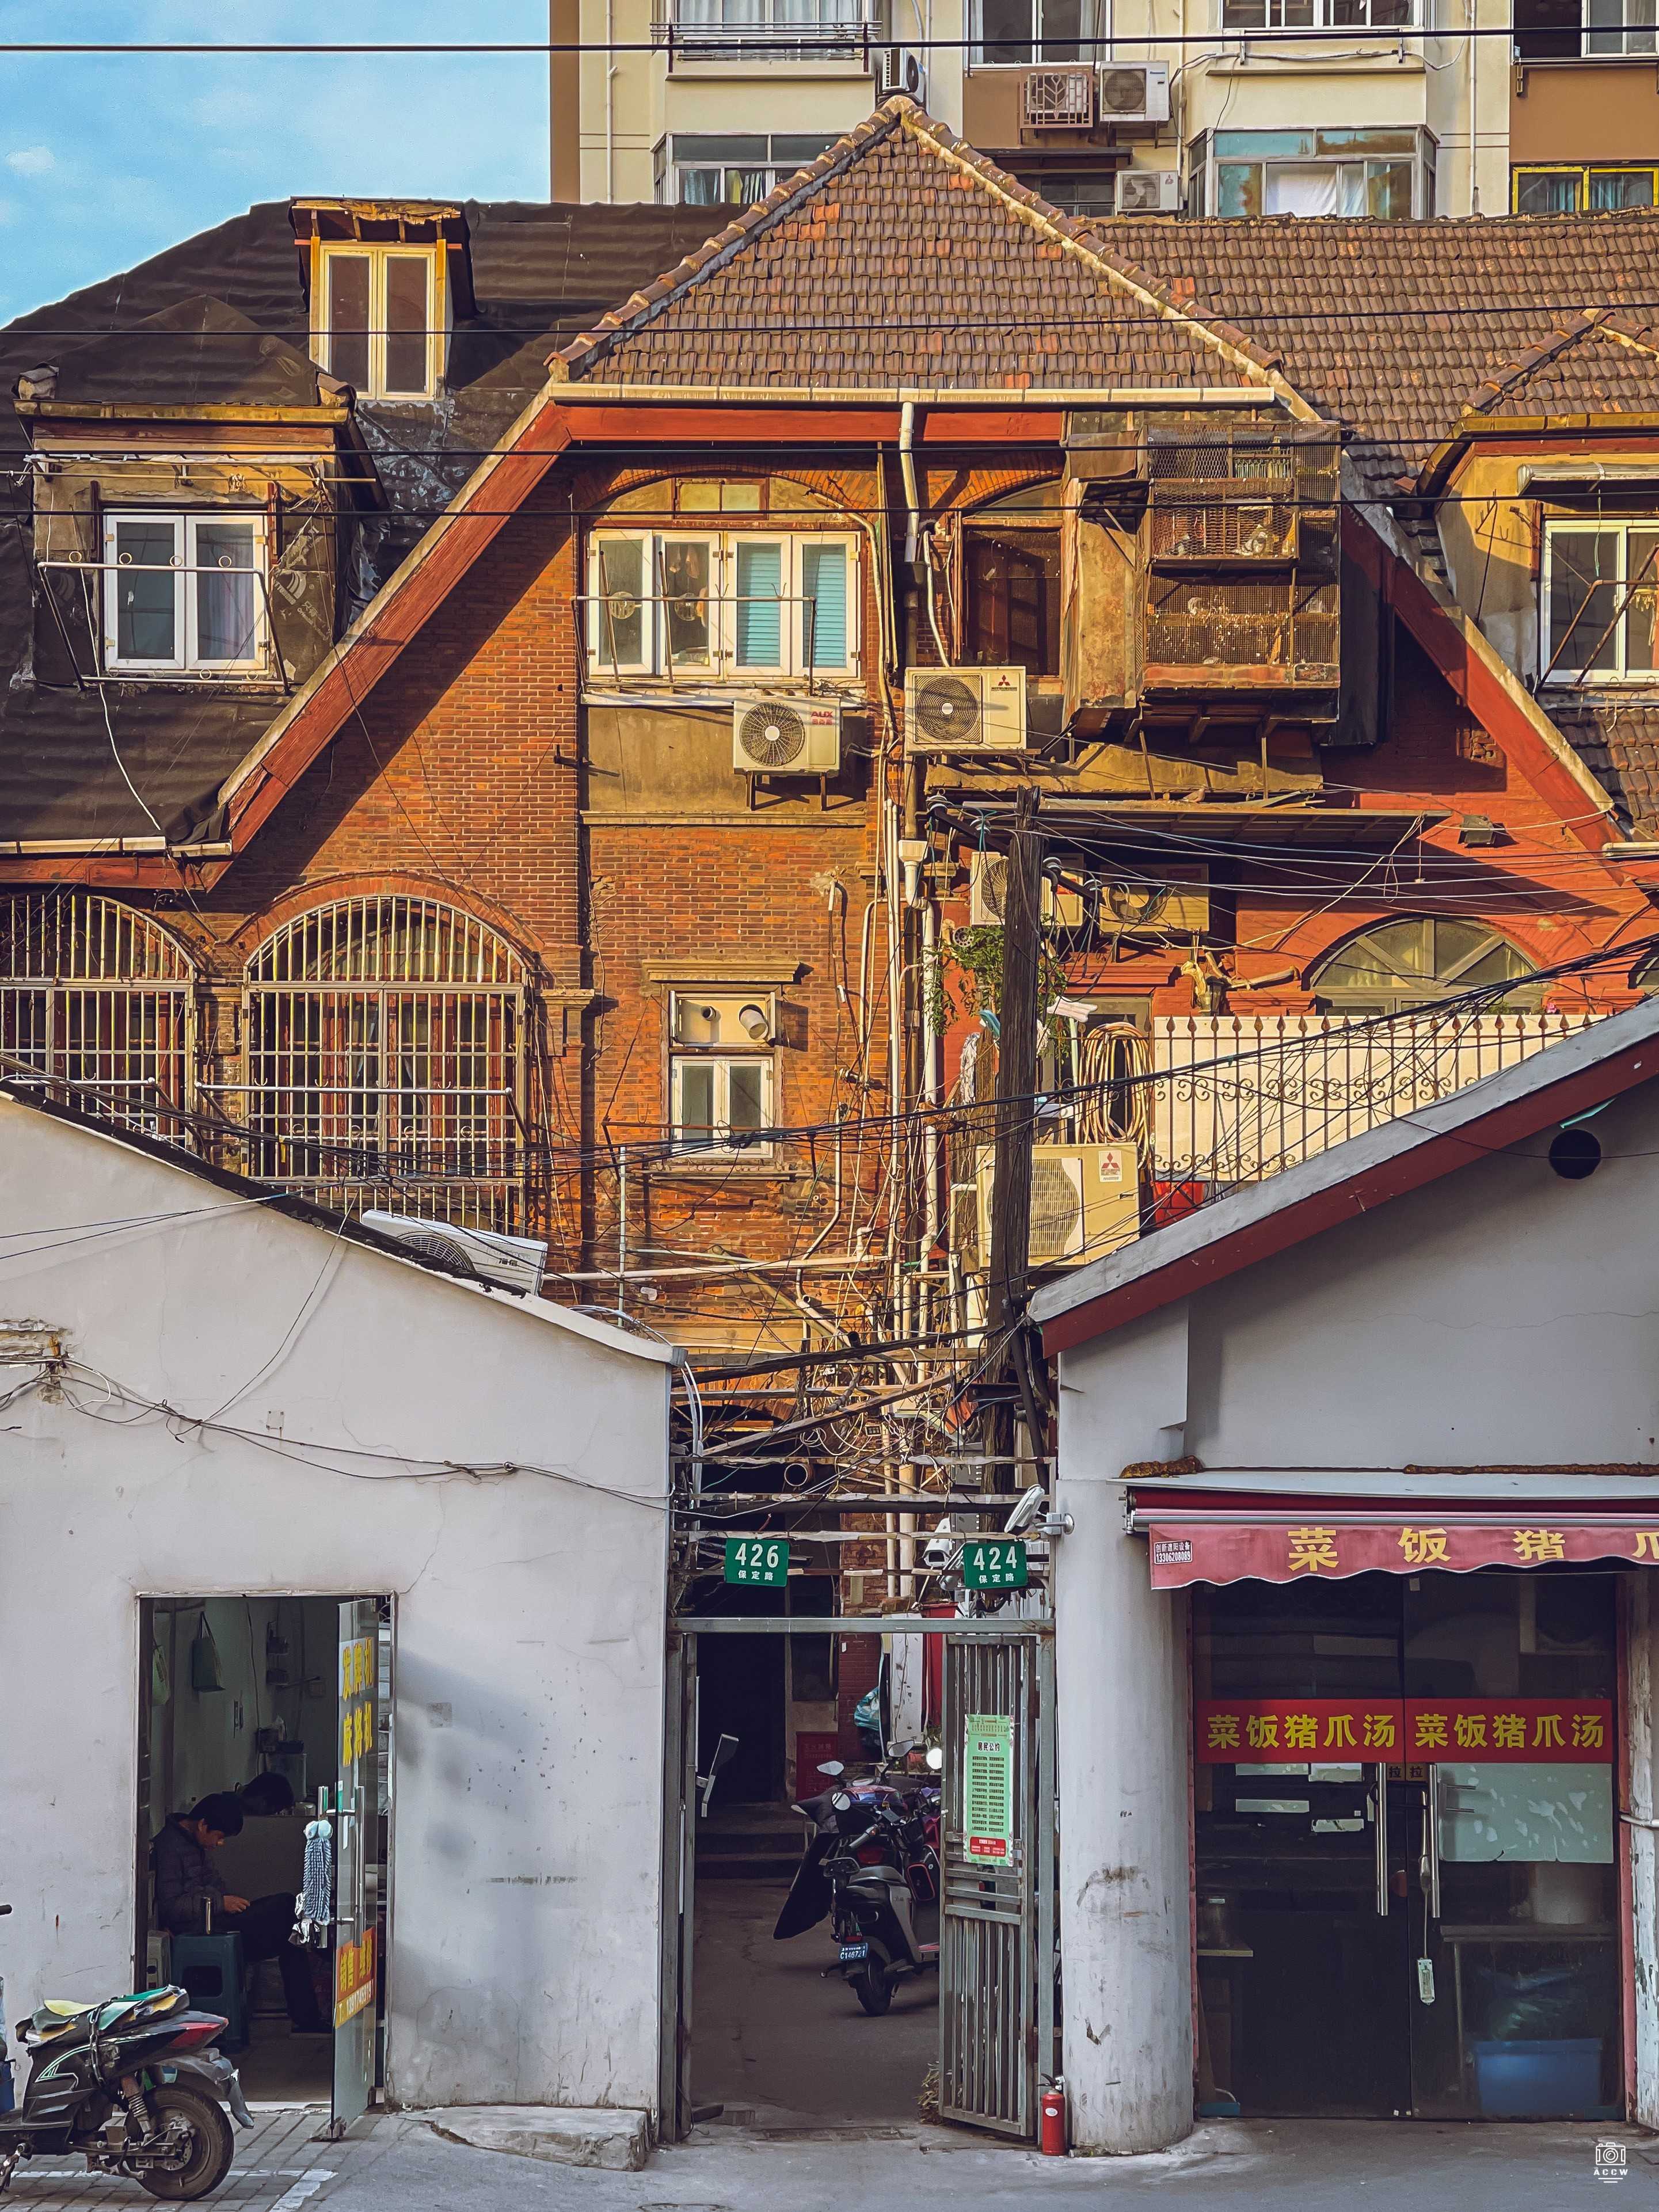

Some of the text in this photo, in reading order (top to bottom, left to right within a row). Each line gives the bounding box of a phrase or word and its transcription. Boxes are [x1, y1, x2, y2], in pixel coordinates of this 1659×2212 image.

[735, 1543, 779, 1568] 426
[973, 1546, 1017, 1571] 424
[738, 1570, 773, 1581] 保定路
[979, 1573, 1014, 1584] 保定路
[1208, 1714, 1395, 1749] 菜饭猪爪汤
[1415, 1714, 1604, 1748] 菜饭猪爪汤
[1388, 1766, 1402, 1779] 拉
[1410, 1766, 1424, 1779] 拉
